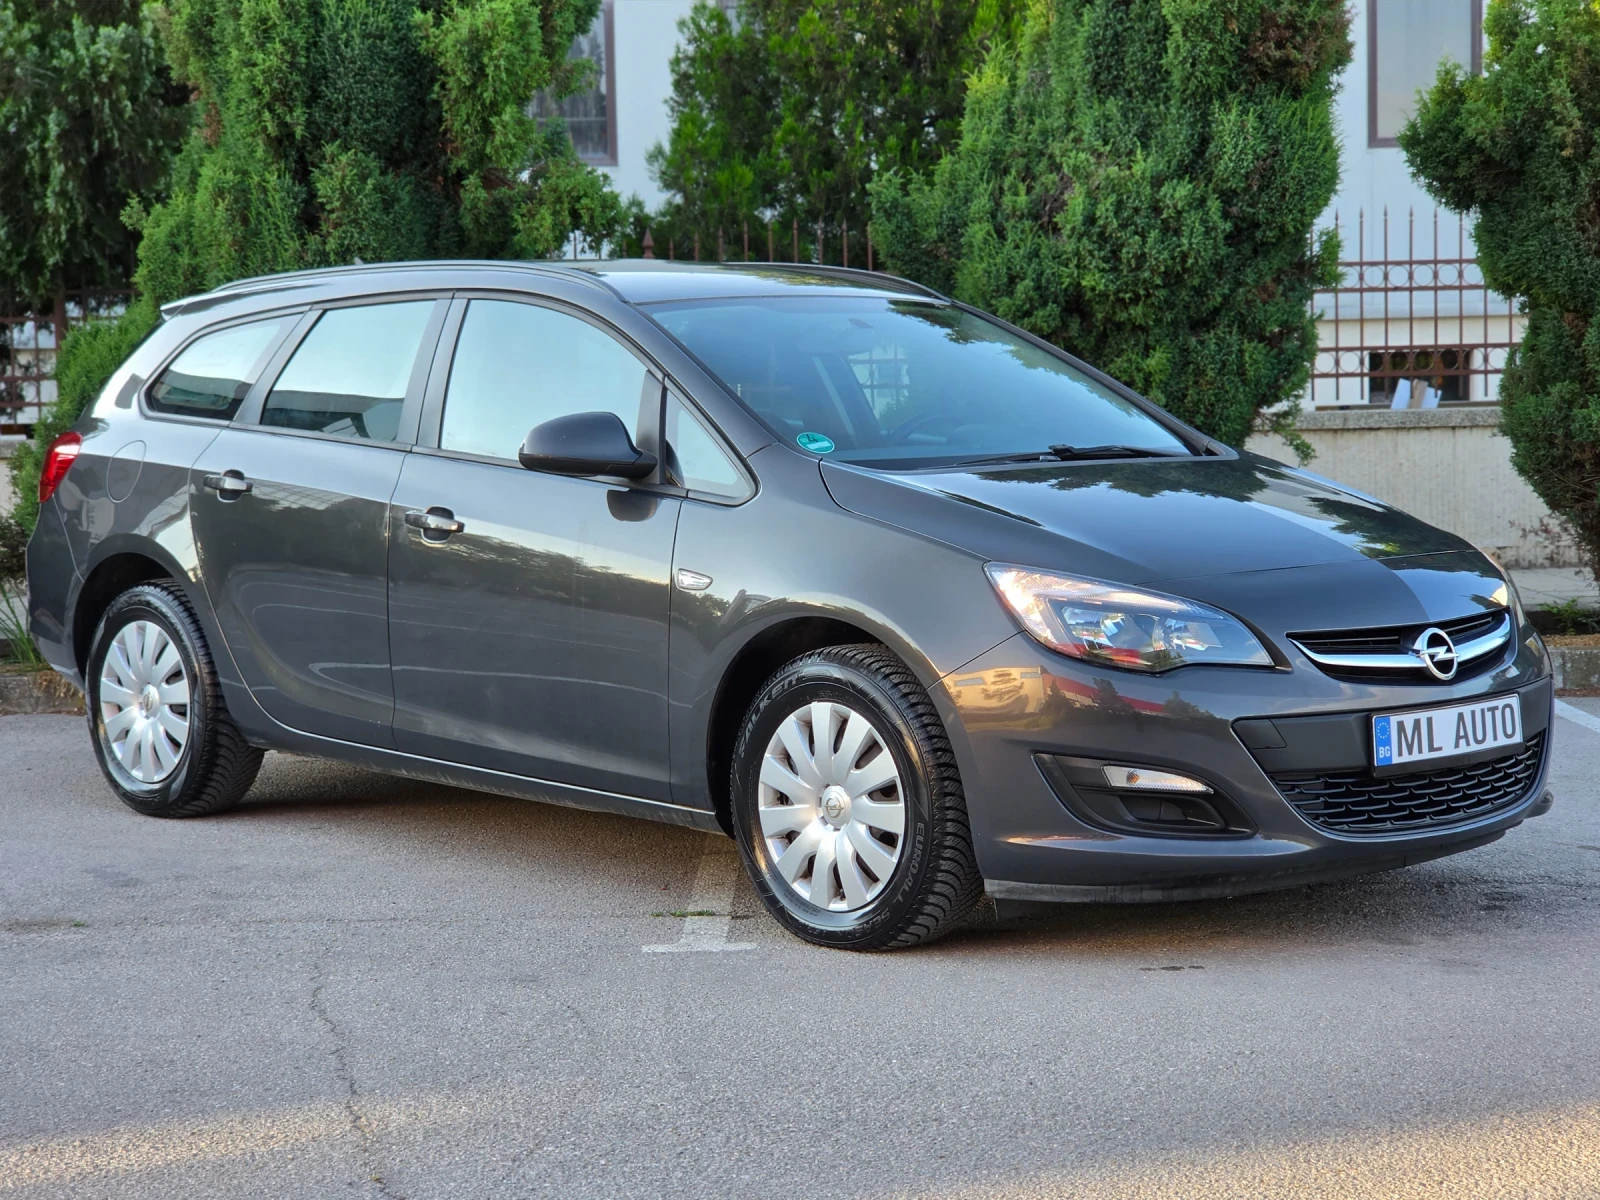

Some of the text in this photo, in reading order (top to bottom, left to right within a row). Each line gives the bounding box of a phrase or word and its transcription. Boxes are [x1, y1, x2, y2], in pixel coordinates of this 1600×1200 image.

[806, 434, 818, 442] 4
[738, 674, 799, 758] FALKEN
[1396, 703, 1517, 758] ML AUTO
[1379, 746, 1391, 759] BG
